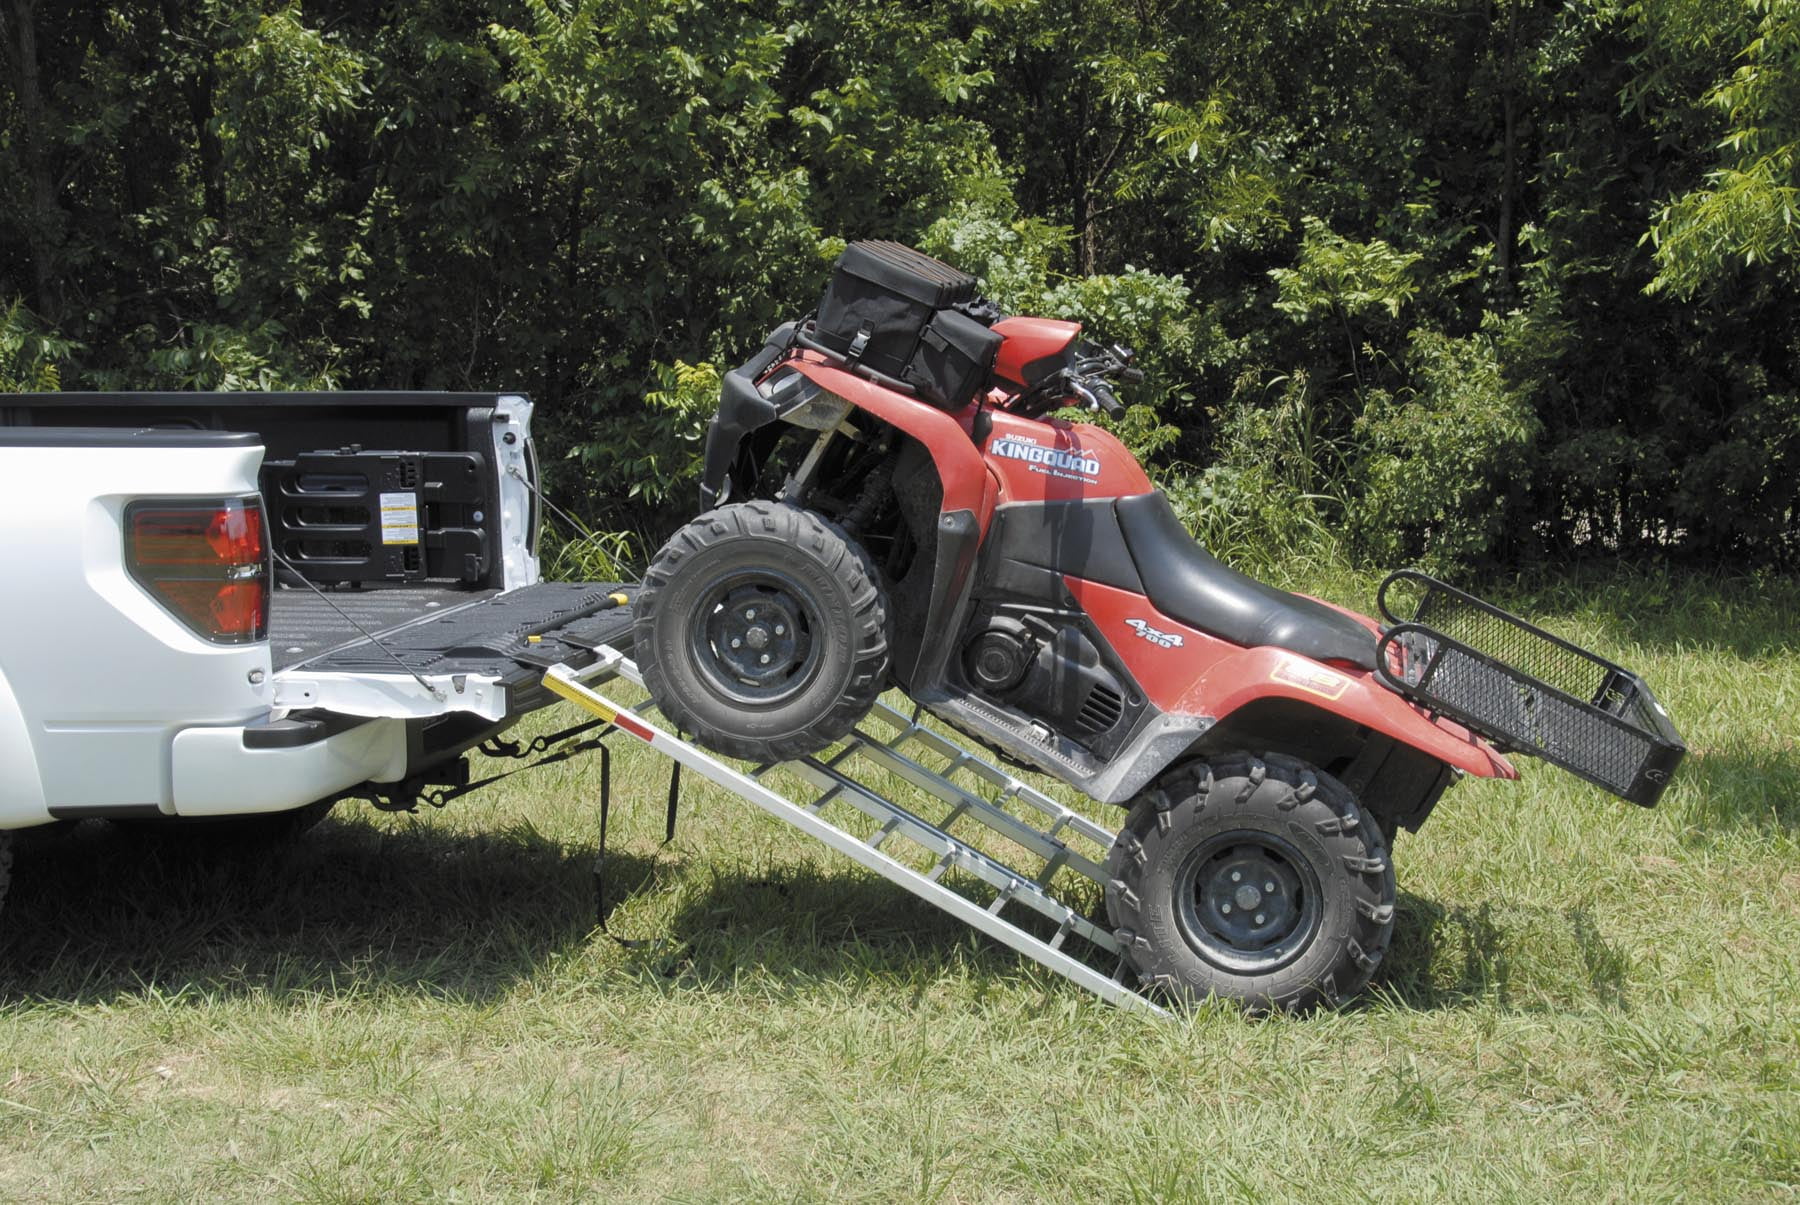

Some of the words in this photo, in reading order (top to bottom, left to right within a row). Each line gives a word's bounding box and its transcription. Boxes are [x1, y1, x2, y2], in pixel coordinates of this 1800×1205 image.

[1005, 433, 1038, 445] SUZUKI
[990, 438, 1100, 476] KINGQUAD
[1135, 627, 1172, 649] 700
